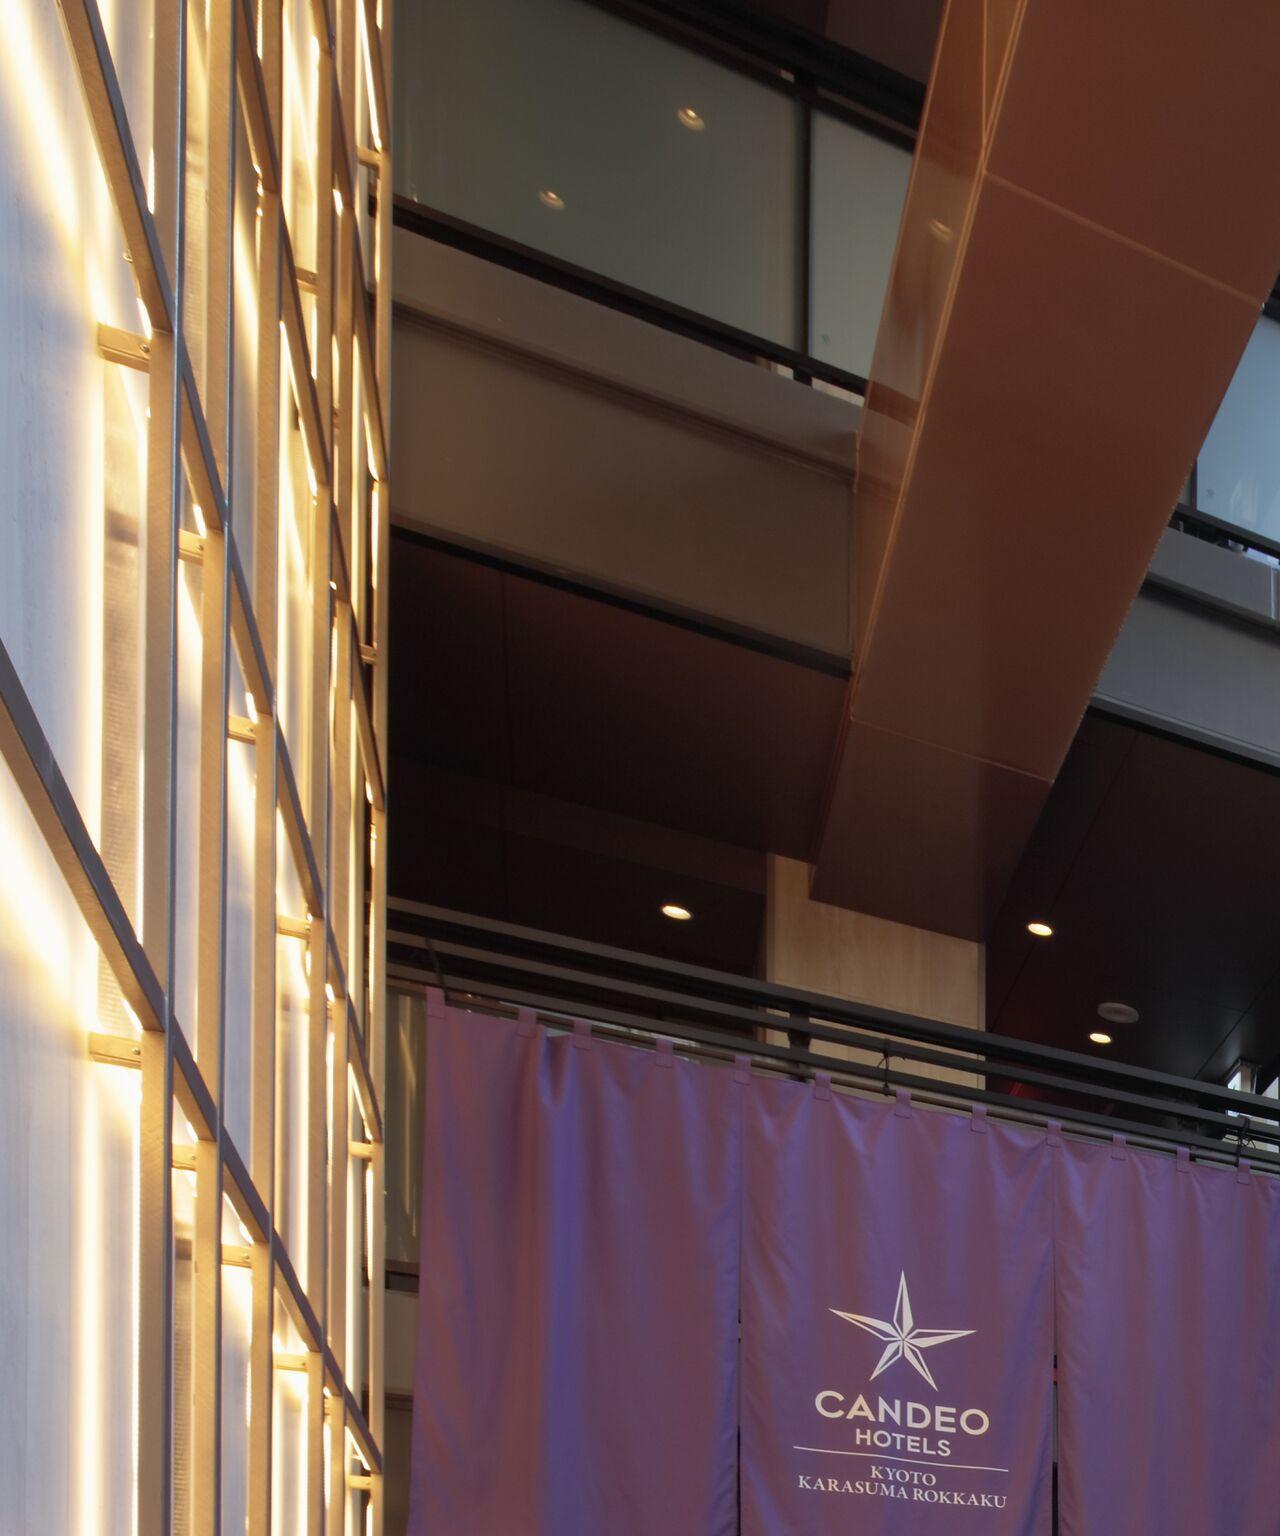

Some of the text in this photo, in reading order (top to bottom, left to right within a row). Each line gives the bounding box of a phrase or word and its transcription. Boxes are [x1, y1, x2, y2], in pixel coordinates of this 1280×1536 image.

[814, 1390, 990, 1436] CANDEO
[855, 1428, 952, 1457] HOTELS
[797, 1474, 1008, 1509] KARASUMA ROKKAKU
[870, 1465, 937, 1486] KYOTO
